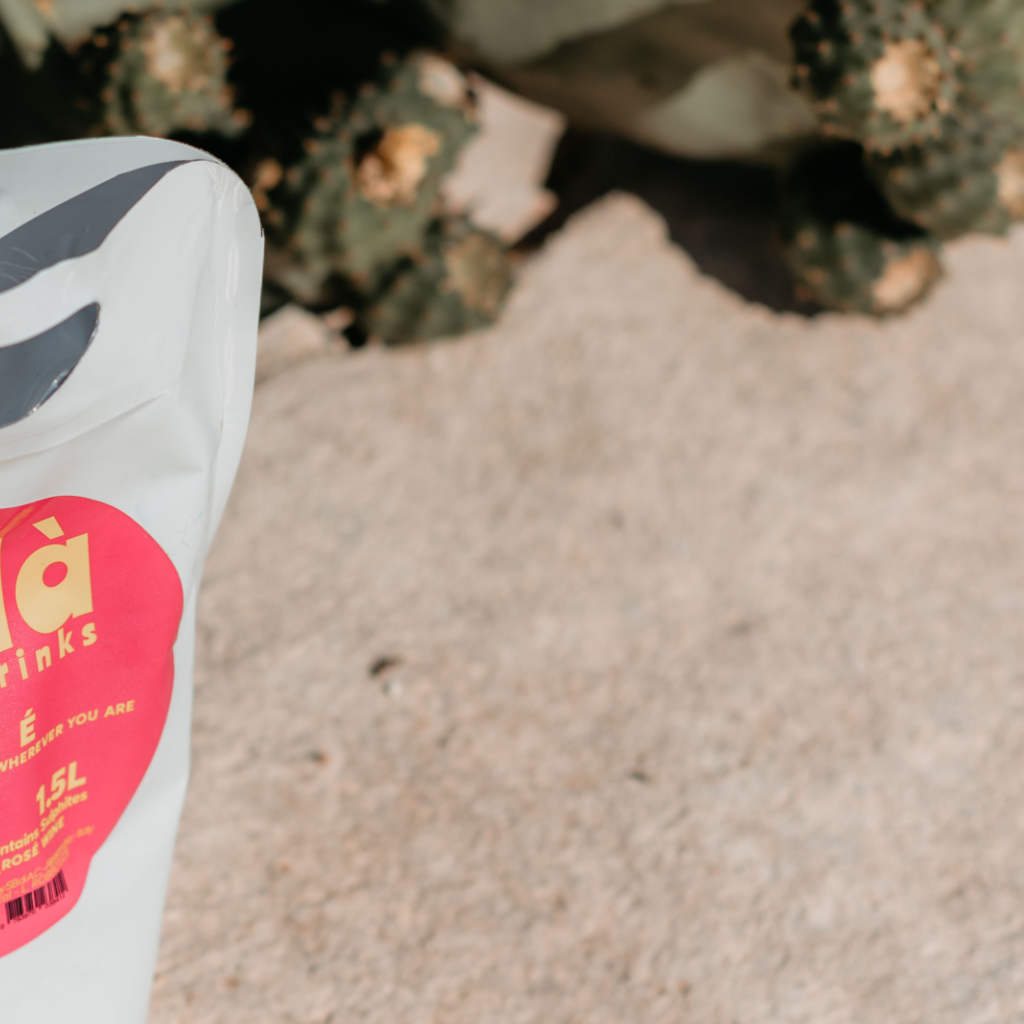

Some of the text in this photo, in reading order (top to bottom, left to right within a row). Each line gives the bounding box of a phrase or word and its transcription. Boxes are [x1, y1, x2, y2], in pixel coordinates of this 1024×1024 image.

[67, 711, 98, 730] YOU
[103, 699, 135, 719] ARE
[41, 815, 65, 849] WINE
